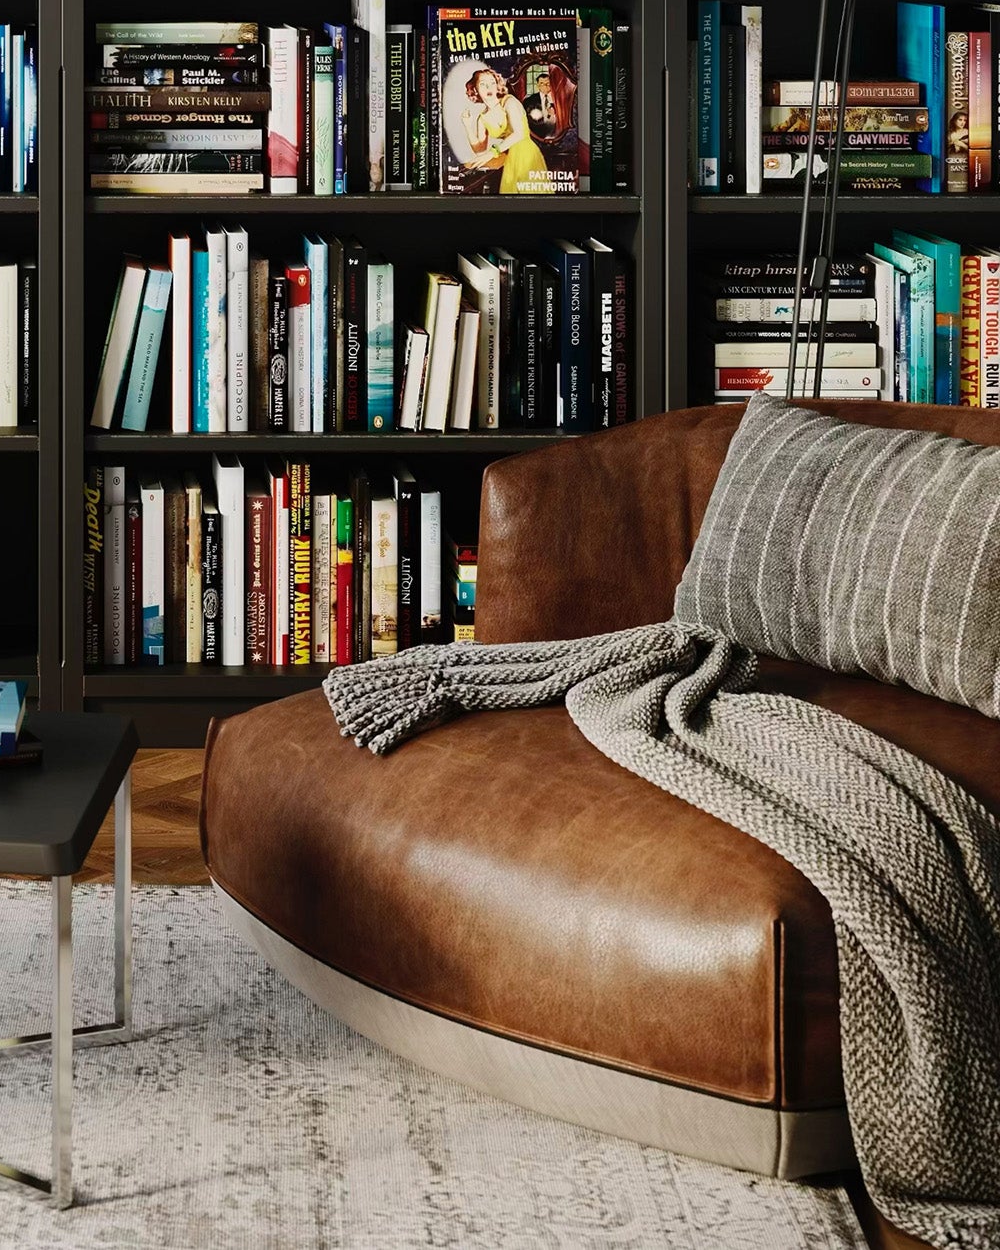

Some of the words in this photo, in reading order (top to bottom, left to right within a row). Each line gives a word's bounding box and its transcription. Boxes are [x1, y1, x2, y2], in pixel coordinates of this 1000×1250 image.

[474, 8, 487, 16] She
[491, 8, 508, 16] Knew
[512, 8, 523, 16] Too
[528, 8, 546, 16] Much
[549, 8, 557, 16] To
[560, 8, 575, 16] Live
[703, 13, 711, 32] THE
[446, 27, 478, 52] the
[480, 20, 515, 49] KEY
[519, 34, 550, 45] unlocks
[553, 30, 567, 39] the
[703, 35, 711, 52] CAT
[128, 53, 149, 62] History
[182, 53, 211, 63] Astrology
[391, 42, 402, 66] THE
[449, 54, 468, 63] door
[471, 53, 480, 61] to
[484, 49, 512, 60] murder
[516, 45, 531, 55] and
[534, 41, 569, 53] violence
[703, 56, 711, 64] IN
[101, 76, 136, 86] Calling
[182, 69, 204, 77] Paul
[207, 69, 220, 77] M.
[182, 77, 225, 86] Strickler
[703, 68, 711, 84] THE
[168, 95, 211, 107] KIRSTEN
[214, 95, 242, 107] KELLY
[391, 69, 402, 112] HOBBIT
[703, 88, 711, 106] HAT
[849, 87, 915, 96] BEETLEJUICE
[126, 112, 172, 123] Games
[175, 112, 224, 124] Hunger
[228, 112, 254, 123] The
[528, 170, 575, 181] PATRICIA
[517, 181, 577, 192] WENTWORTH
[571, 263, 581, 280] THE
[725, 263, 760, 277] kitap
[375, 274, 383, 300] Robinson
[615, 274, 626, 295] THE
[727, 286, 740, 294] SIX
[741, 286, 777, 294] CENTURY
[778, 286, 808, 294] FAMY
[962, 256, 978, 320] HARD
[986, 278, 999, 306] RUN
[571, 283, 581, 312] KING'S
[375, 301, 383, 322] Crusoe
[615, 298, 626, 339] SNOWS
[571, 315, 581, 345] BLOOD
[602, 292, 612, 372] MACBETH
[962, 327, 978, 350] IT
[984, 311, 999, 360] TOUGH,
[615, 341, 626, 353] of
[570, 366, 578, 391] SABRINA
[962, 358, 978, 408] PLAY
[986, 363, 999, 388] RUN
[615, 362, 626, 425] GANYMEDE
[570, 392, 578, 419] ZBASNIK
[294, 538, 311, 584] BOOK
[401, 556, 413, 604] INIQUITY
[247, 591, 258, 650] HOGWARTS
[258, 592, 266, 636] HISTORY
[206, 621, 215, 646] HARPER
[294, 591, 311, 665] MYSTERY
[206, 647, 215, 659] LEE
